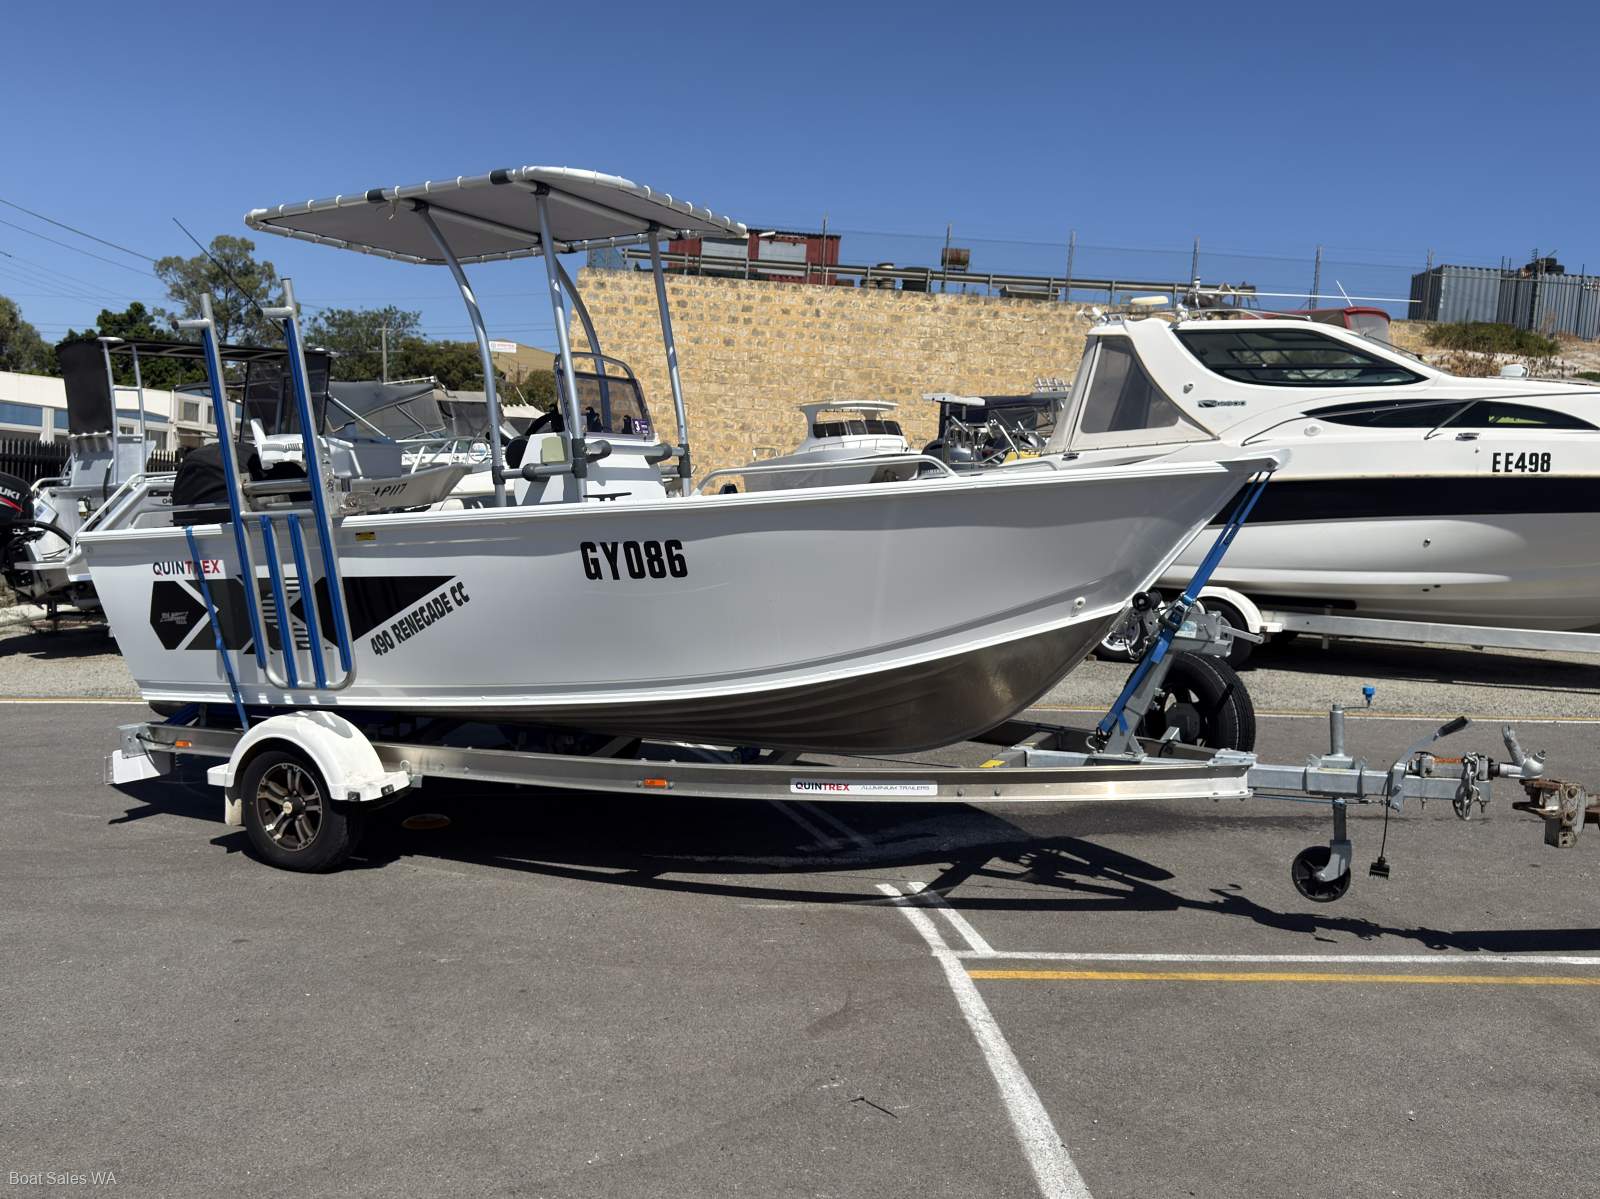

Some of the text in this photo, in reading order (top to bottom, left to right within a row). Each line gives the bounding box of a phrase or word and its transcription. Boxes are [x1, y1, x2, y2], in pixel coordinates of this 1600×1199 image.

[1492, 452, 1551, 473] EE498
[580, 539, 688, 580] GY086
[370, 581, 470, 656] 490 RENEGADE CC
[795, 781, 850, 792] QUINTREX
